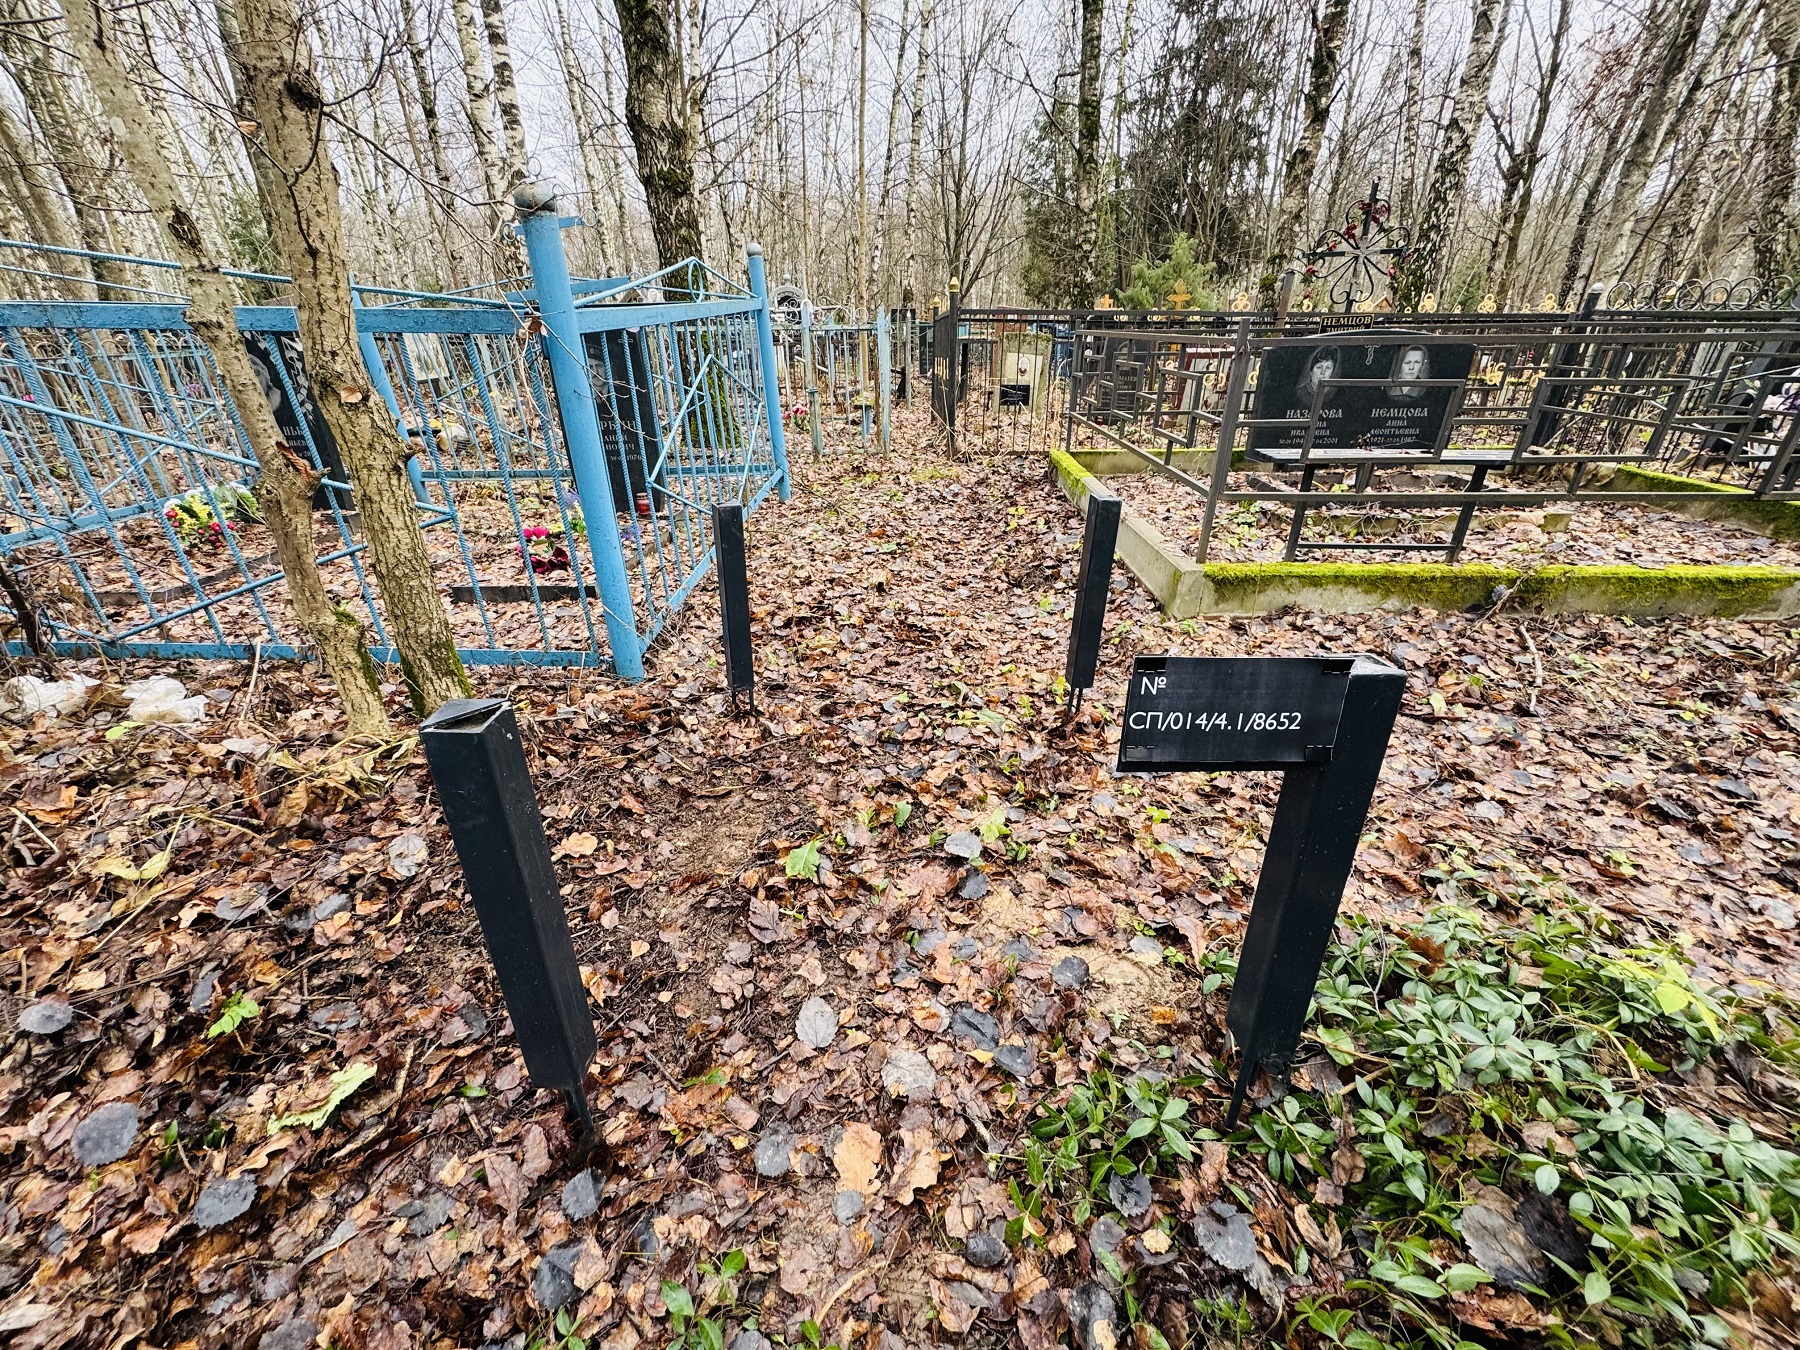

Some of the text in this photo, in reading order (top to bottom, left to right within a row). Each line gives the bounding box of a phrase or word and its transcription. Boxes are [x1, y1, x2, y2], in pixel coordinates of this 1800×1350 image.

[1323, 317, 1371, 326] НЕМЦОВ
[1370, 407, 1428, 418] НЕМЦОВА
[1141, 676, 1167, 695] №
[1129, 712, 1302, 732] СП/014/4.1/8652
